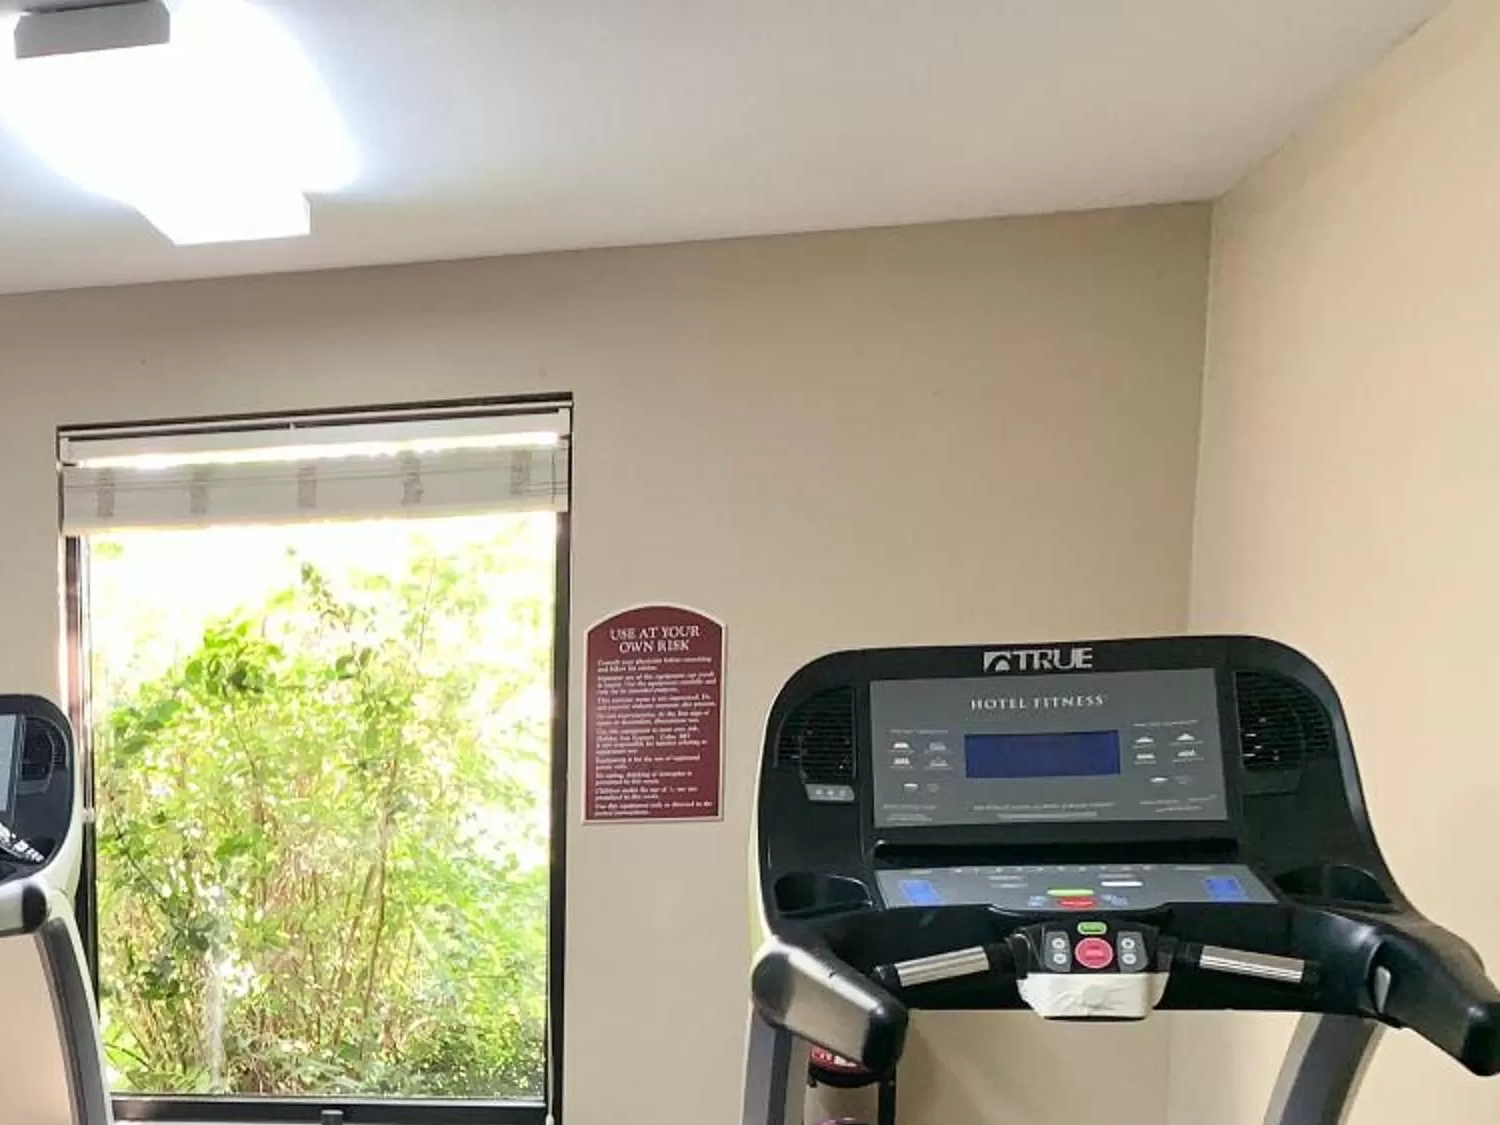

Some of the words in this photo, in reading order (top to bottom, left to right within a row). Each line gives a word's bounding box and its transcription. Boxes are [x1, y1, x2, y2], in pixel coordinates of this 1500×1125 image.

[609, 627, 636, 641] USE
[639, 626, 659, 639] AT
[661, 625, 700, 639] YOUR
[619, 639, 654, 654] OWN
[657, 639, 690, 653] RISK
[1011, 647, 1093, 671] TRUE
[970, 698, 1028, 711] HOTEL
[1033, 694, 1104, 710] FITNESS
